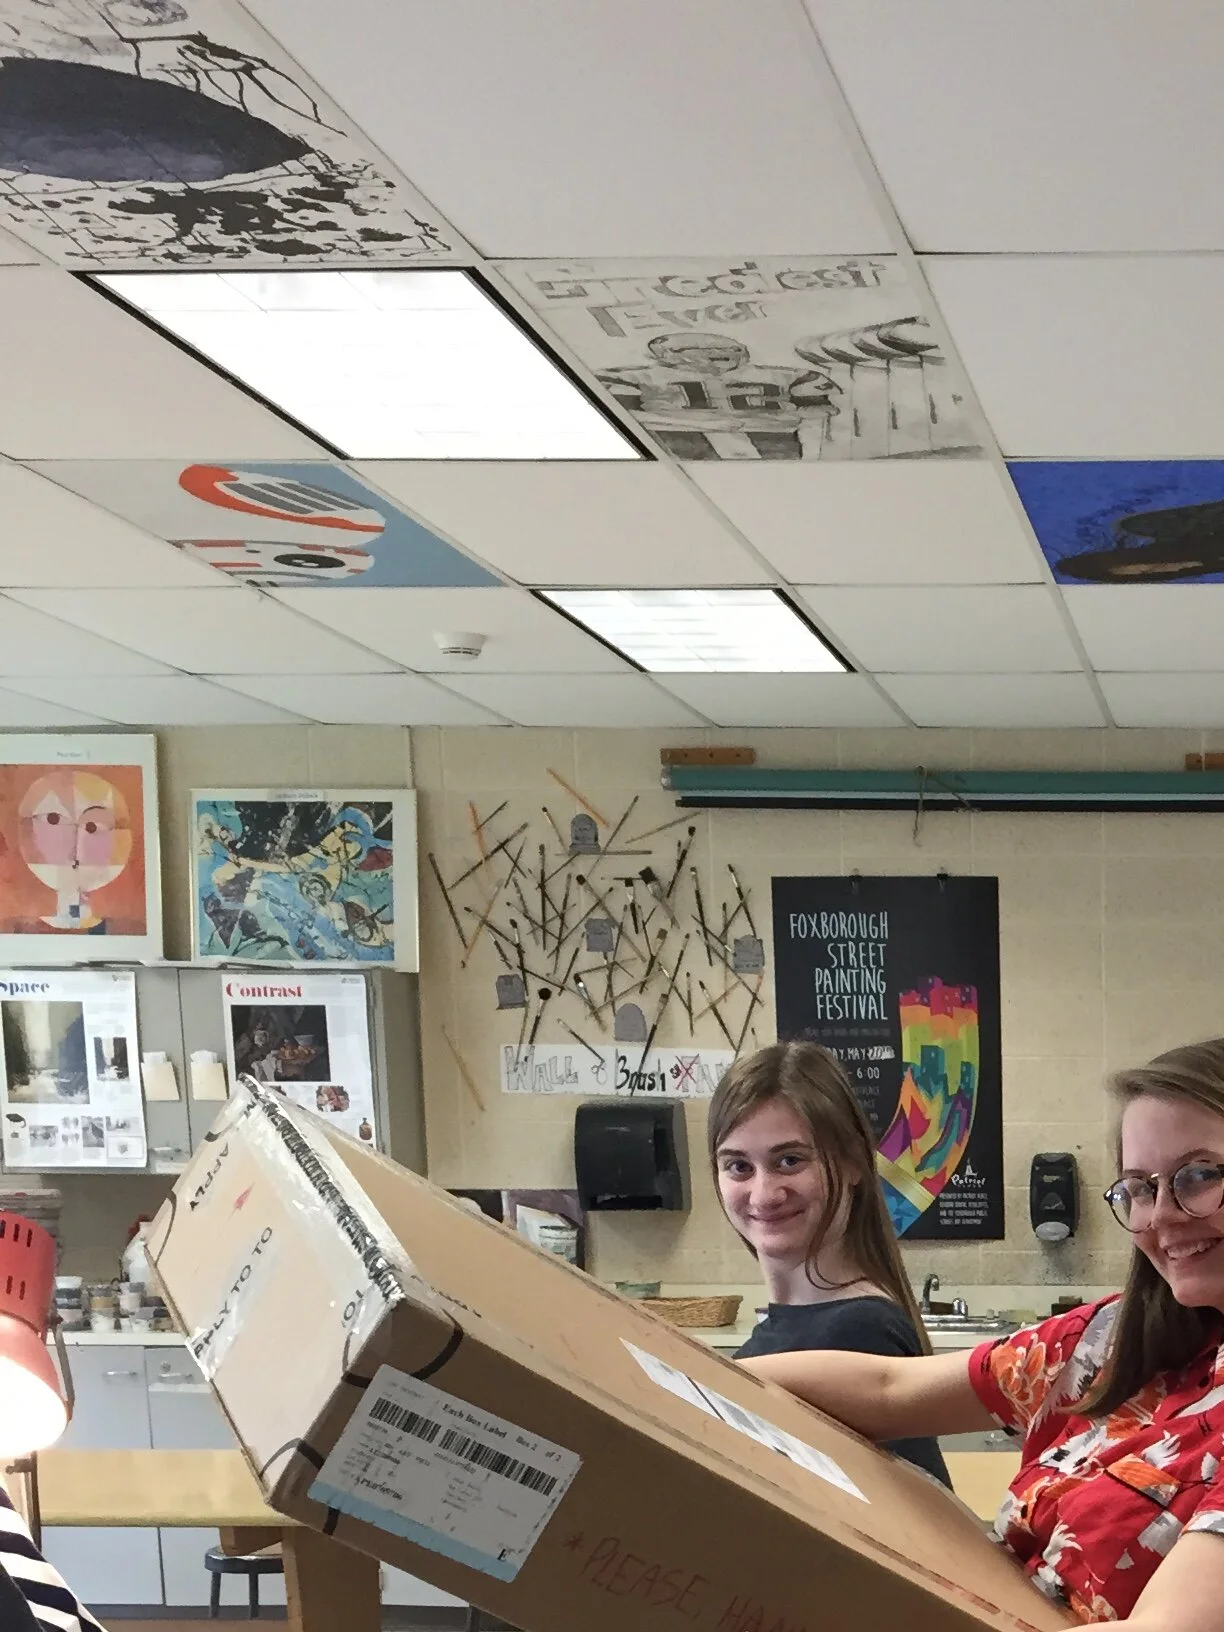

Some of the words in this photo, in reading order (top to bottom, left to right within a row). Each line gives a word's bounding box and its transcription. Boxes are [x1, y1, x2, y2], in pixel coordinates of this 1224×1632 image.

[789, 911, 889, 939] FOXBOROUGH
[827, 941, 887, 968] STREET
[225, 981, 303, 999] Contrast
[815, 968, 886, 994] PAINTING
[816, 994, 888, 1021] FESTIVAL
[231, 1264, 252, 1293] TO
[580, 1536, 709, 1621] PLEASE,
